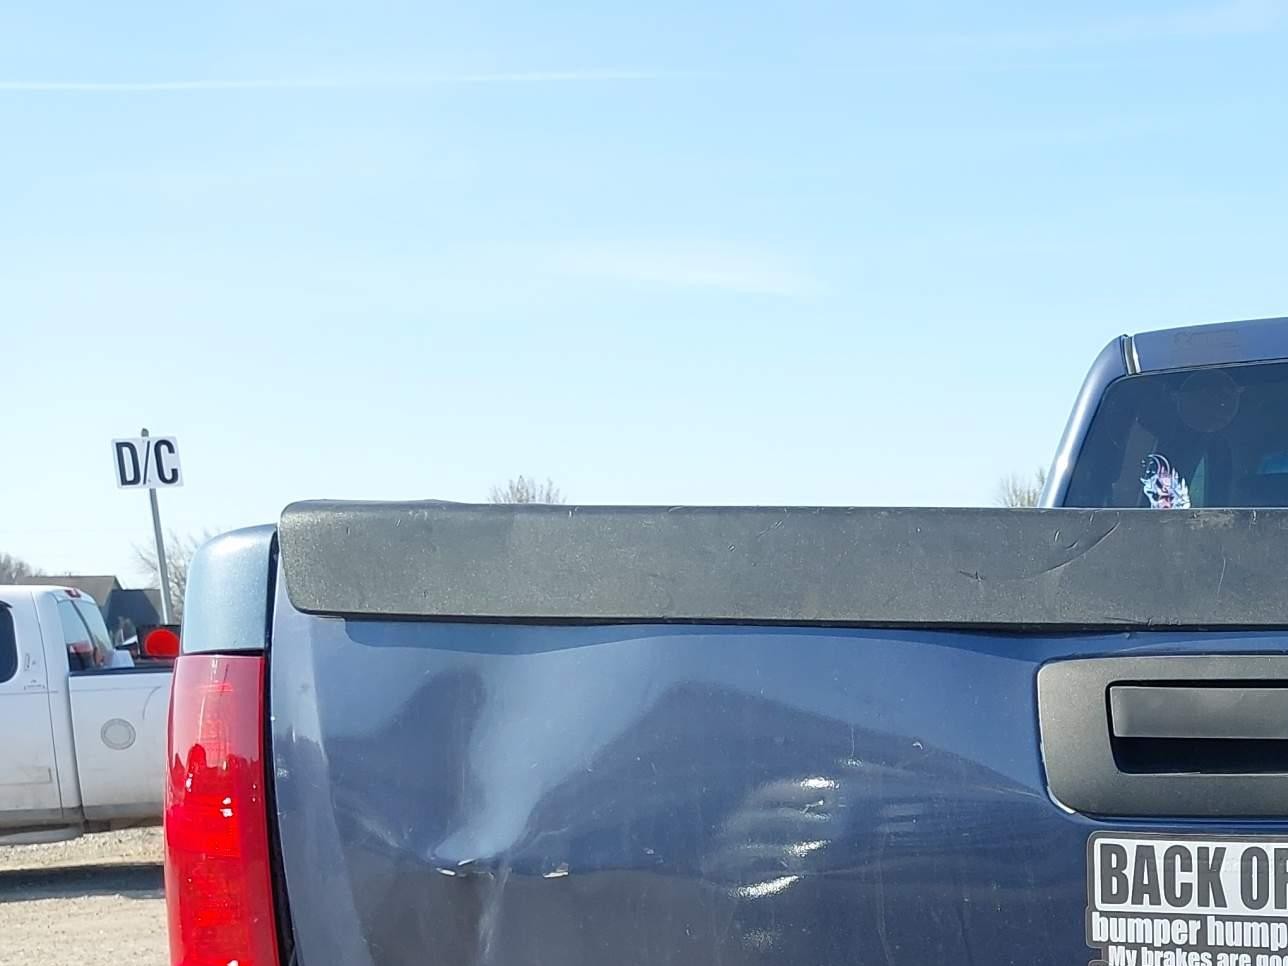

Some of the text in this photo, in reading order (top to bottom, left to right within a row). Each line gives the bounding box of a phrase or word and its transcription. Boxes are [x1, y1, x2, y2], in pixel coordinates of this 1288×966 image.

[115, 439, 179, 486] D/C
[1099, 843, 1228, 909] BACK
[1092, 912, 1201, 947] bumper
